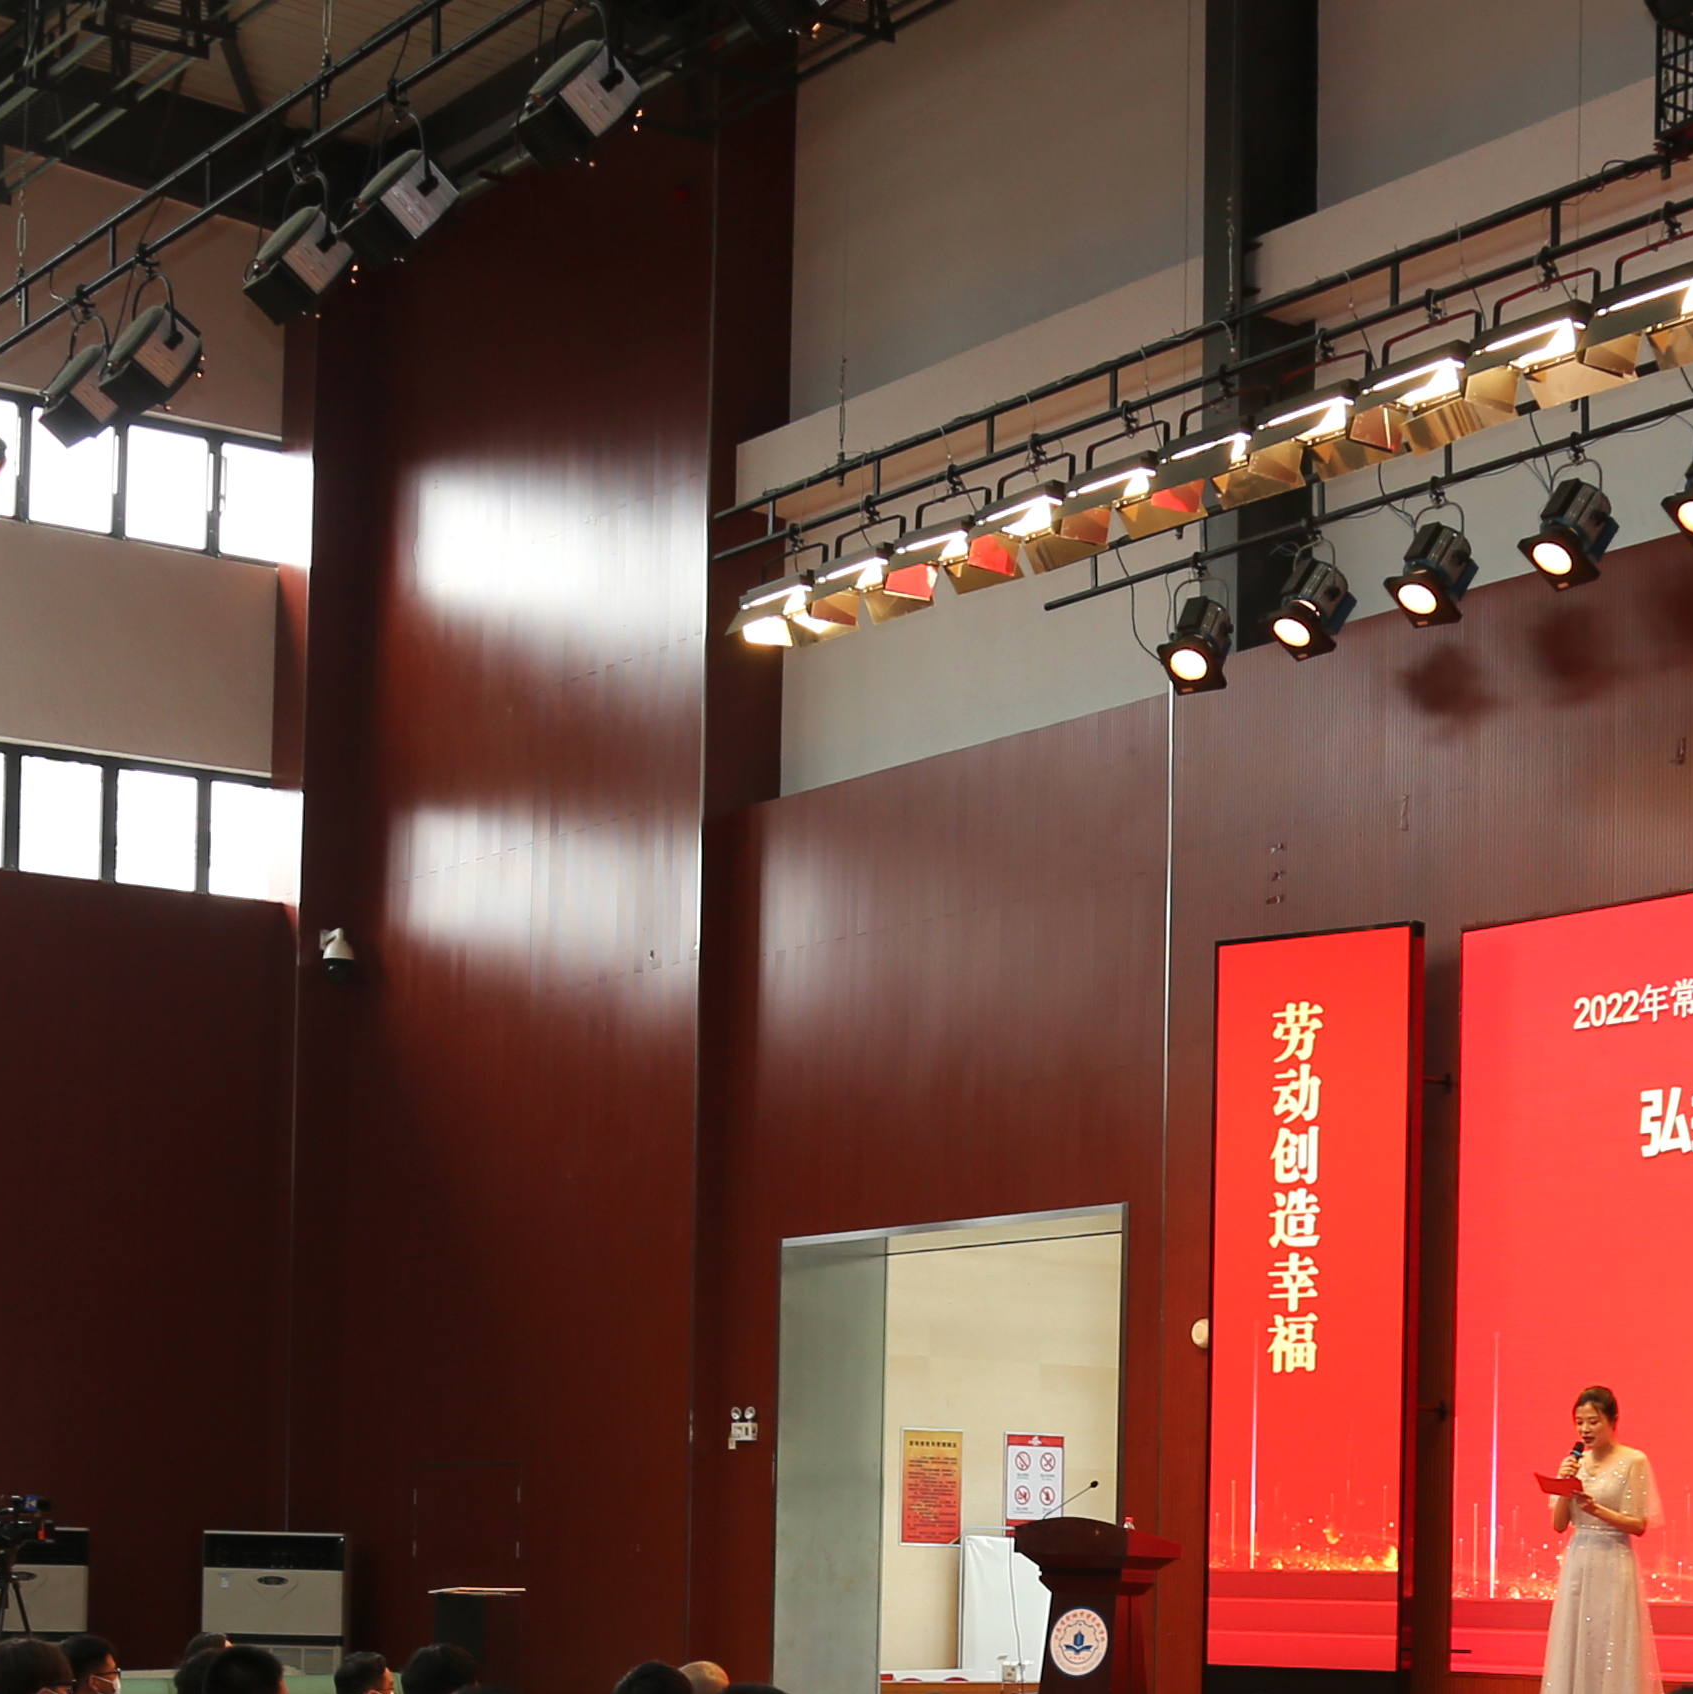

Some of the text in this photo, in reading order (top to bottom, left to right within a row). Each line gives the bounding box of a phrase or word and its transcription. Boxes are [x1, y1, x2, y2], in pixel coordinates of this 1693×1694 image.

[1267, 1001, 1324, 1374] 劳动创造幸福
